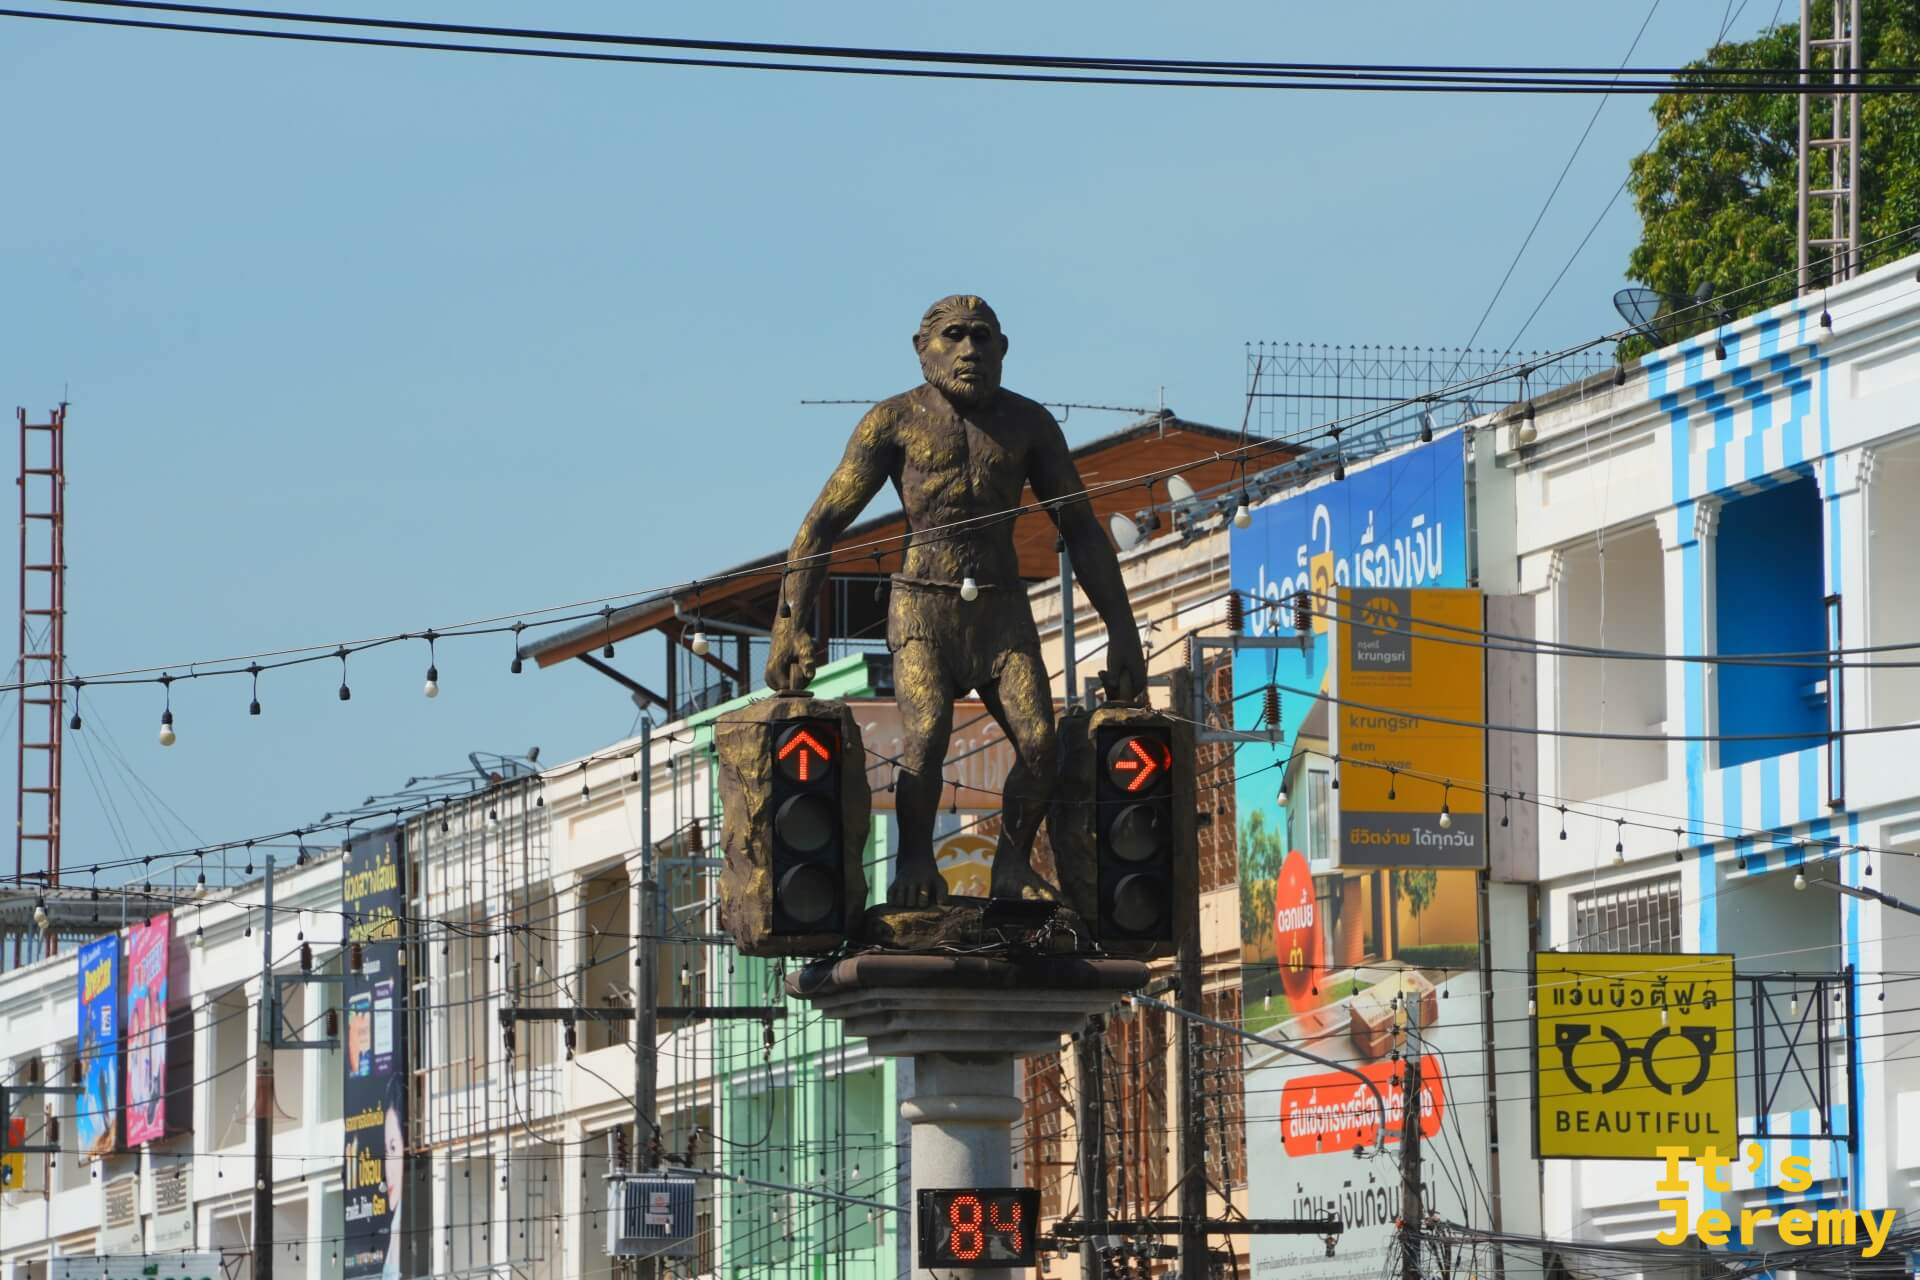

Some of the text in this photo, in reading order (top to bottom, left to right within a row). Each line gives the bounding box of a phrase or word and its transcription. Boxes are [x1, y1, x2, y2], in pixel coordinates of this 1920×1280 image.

[1357, 650, 1406, 664] krungsri
[1349, 712, 1419, 733] krungsri
[1351, 741, 1376, 752] atm
[1412, 827, 1475, 851] ได้ทุกวัน
[1278, 888, 1313, 933] ดอกเบี้ย
[1555, 1110, 1720, 1134] BEAUTIFUL
[949, 1195, 1024, 1260] 84
